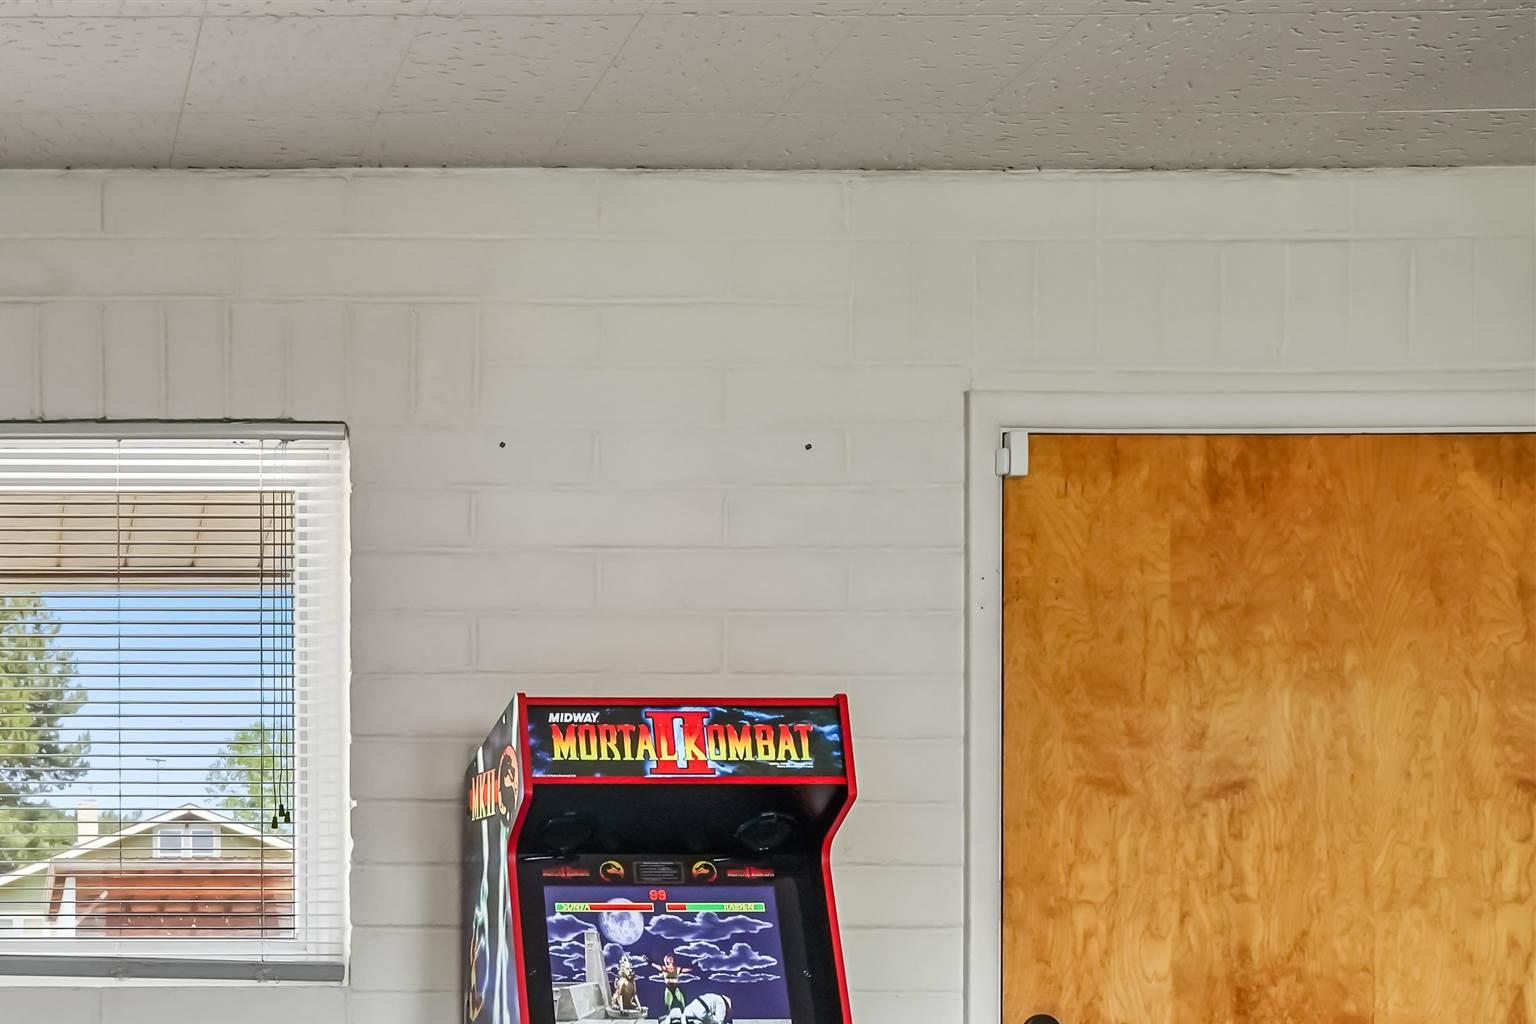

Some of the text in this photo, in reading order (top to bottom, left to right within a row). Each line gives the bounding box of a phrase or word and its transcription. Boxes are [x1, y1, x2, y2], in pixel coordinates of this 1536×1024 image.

[548, 712, 600, 723] MIDWAY
[550, 723, 814, 761] MORTAL KOMBAT
[649, 889, 667, 900] 99
